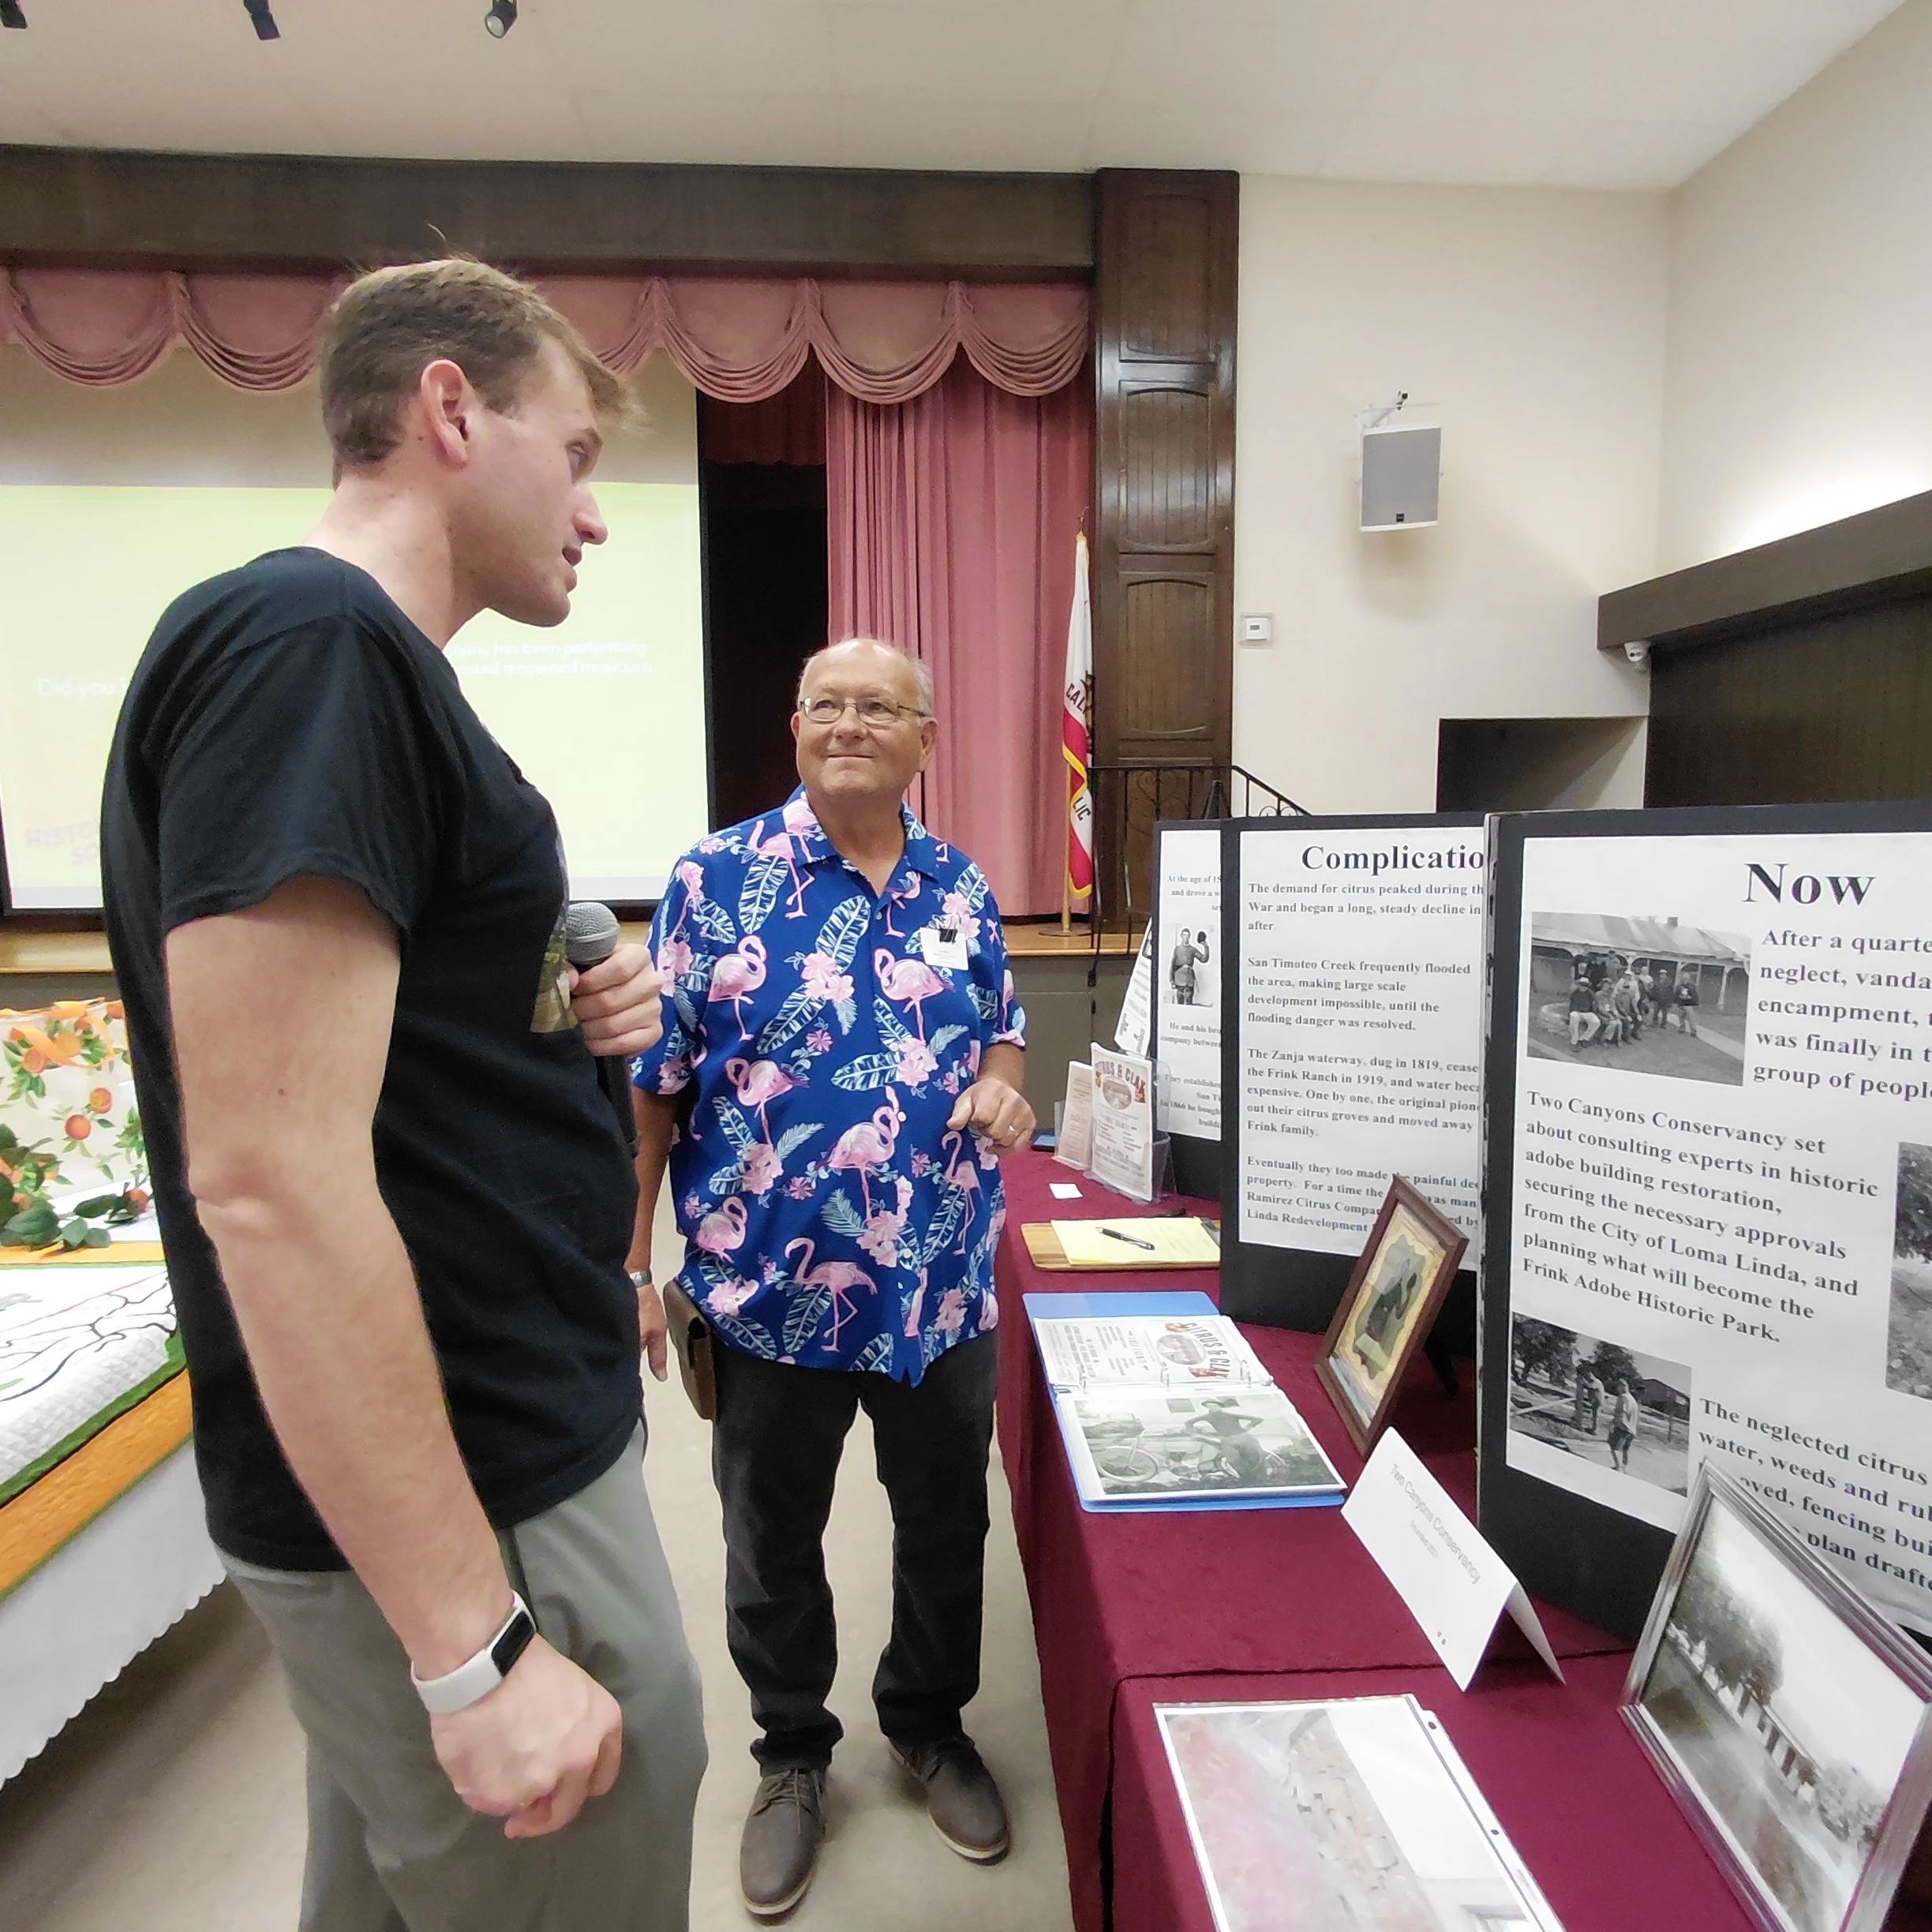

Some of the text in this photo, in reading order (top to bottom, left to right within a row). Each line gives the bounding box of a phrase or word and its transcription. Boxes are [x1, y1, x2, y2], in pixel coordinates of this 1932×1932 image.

[1301, 844, 1484, 877] Complicatio
[1247, 882, 1271, 894] The
[1271, 883, 1318, 894] demand
[1321, 883, 1339, 894] for
[1341, 882, 1376, 894] citrus
[1378, 883, 1422, 897] peaked
[1425, 883, 1469, 897] during
[1741, 863, 1877, 907] Now
[1247, 900, 1481, 916] War and began a long, steady decline in
[1761, 929, 1824, 948] After
[1829, 936, 1843, 949] a
[1246, 957, 1471, 975] San Timoteo Creek frequently flooded
[1759, 964, 1848, 988] neglect,
[1247, 975, 1406, 993] the area, making large scale
[1247, 994, 1440, 1013] development impossible, until the
[1758, 999, 1919, 1028] encampment,
[1247, 1012, 1417, 1031] flooding danger was resolved.
[1246, 1047, 1271, 1060] The
[1271, 1050, 1305, 1065] Zanja
[1369, 1056, 1393, 1070] dug
[1395, 1057, 1407, 1069] in
[1411, 1058, 1444, 1073] 1819,
[1755, 1032, 1913, 1062] was finally in
[1247, 1066, 1267, 1077] the
[1267, 1069, 1298, 1080] Frink
[1301, 1070, 1339, 1084] Ranch
[1340, 1073, 1353, 1084] in
[1356, 1073, 1388, 1088] 1919,
[1389, 1076, 1413, 1088] and
[1415, 1080, 1453, 1091] water
[1753, 1065, 1822, 1090] group
[1828, 1072, 1856, 1090] of
[1246, 1087, 1303, 1099] expensive.
[1305, 1088, 1330, 1101] One
[1331, 1090, 1347, 1105] by
[1376, 1094, 1395, 1105] the
[1398, 1095, 1447, 1110] original
[1246, 1104, 1473, 1133] out their citrus groves and moved away
[1247, 1119, 1279, 1133] Frink
[1526, 1090, 1826, 1155] Two Canyons Conservancy set
[1246, 1155, 1306, 1174] Eventually
[1308, 1163, 1332, 1177] they
[1335, 1166, 1354, 1177] too
[1356, 1169, 1389, 1181] made
[1413, 1174, 1457, 1188] painful
[1526, 1120, 1879, 1197] about consulting experts in historic
[1304, 1179, 1325, 1192] For
[1336, 1184, 1363, 1196] time
[1365, 1186, 1384, 1199] the
[1450, 1197, 1478, 1210] man
[1525, 1149, 1783, 1216] adobe building restoration,
[1246, 1190, 1334, 1211] Ramirez Citrus
[1247, 1208, 1368, 1233] Linda Redevelopment
[1524, 1178, 1847, 1260] securing the necessary approvals
[1523, 1203, 1859, 1297] from the City of Loma Linda, and
[1522, 1231, 1815, 1320] planning what will become the
[1522, 1256, 1780, 1343] Frink Adobe Historic Park.
[1698, 1397, 1928, 1486] The neglected citrus
[1698, 1431, 1765, 1466] water,
[1769, 1455, 1837, 1489] weeds
[1843, 1482, 1889, 1507] and
[1801, 1496, 1888, 1544] fencing
[1432, 1517, 1482, 1585] Conservancy
